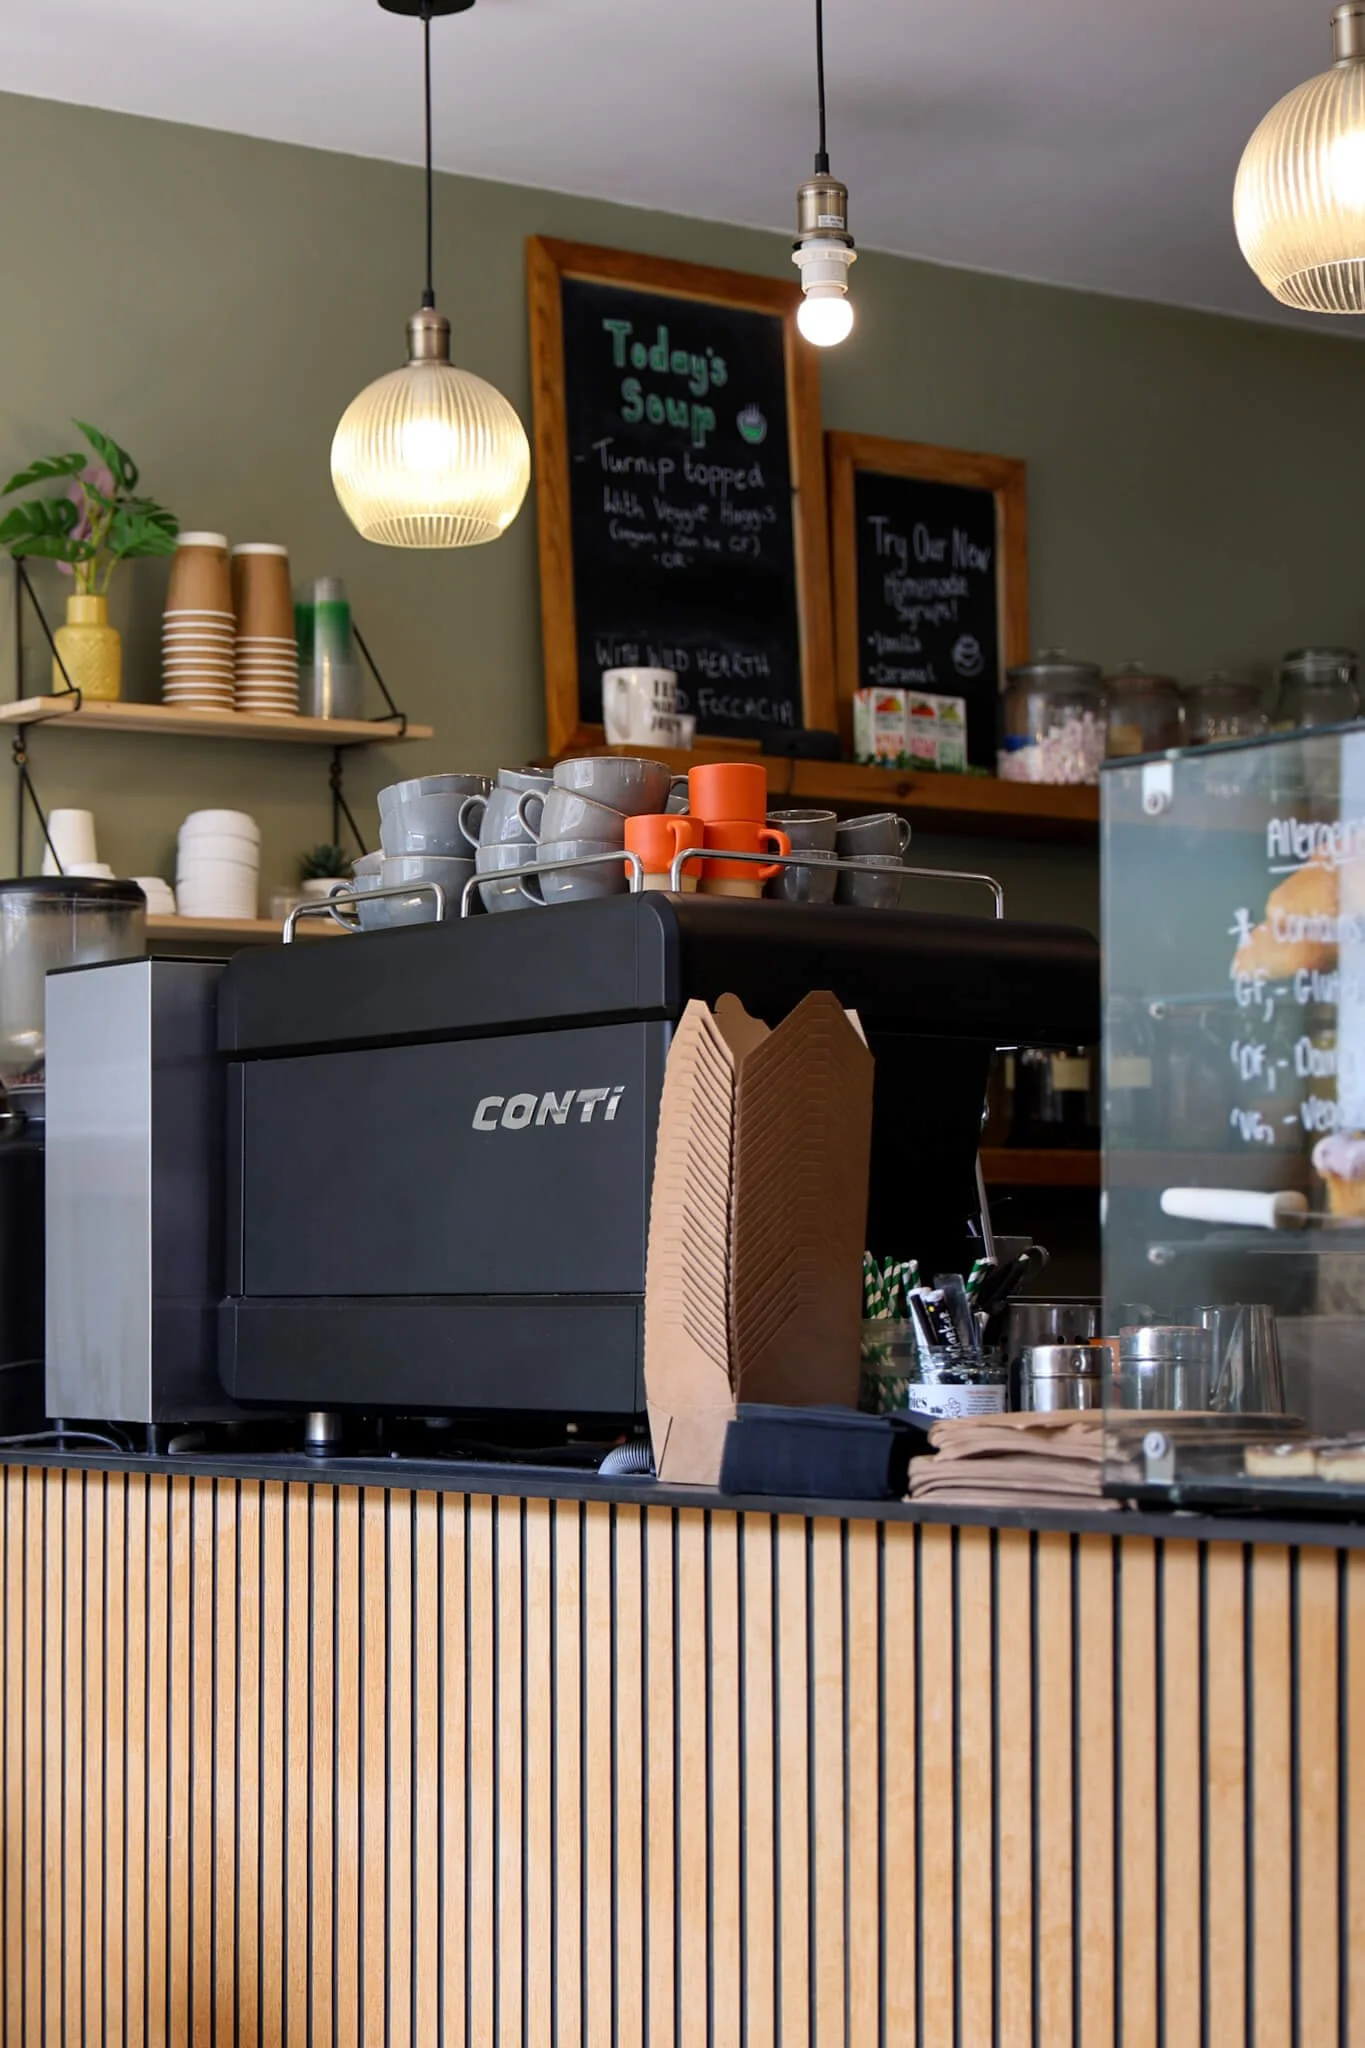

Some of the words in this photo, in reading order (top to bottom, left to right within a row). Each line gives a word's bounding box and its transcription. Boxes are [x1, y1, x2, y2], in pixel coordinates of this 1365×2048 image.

[603, 318, 729, 396] Today's
[620, 376, 716, 449] Soup
[592, 437, 676, 492] Turnip
[683, 452, 766, 498] topped
[868, 515, 909, 577] Try
[912, 521, 949, 564] Our
[951, 526, 993, 574] New
